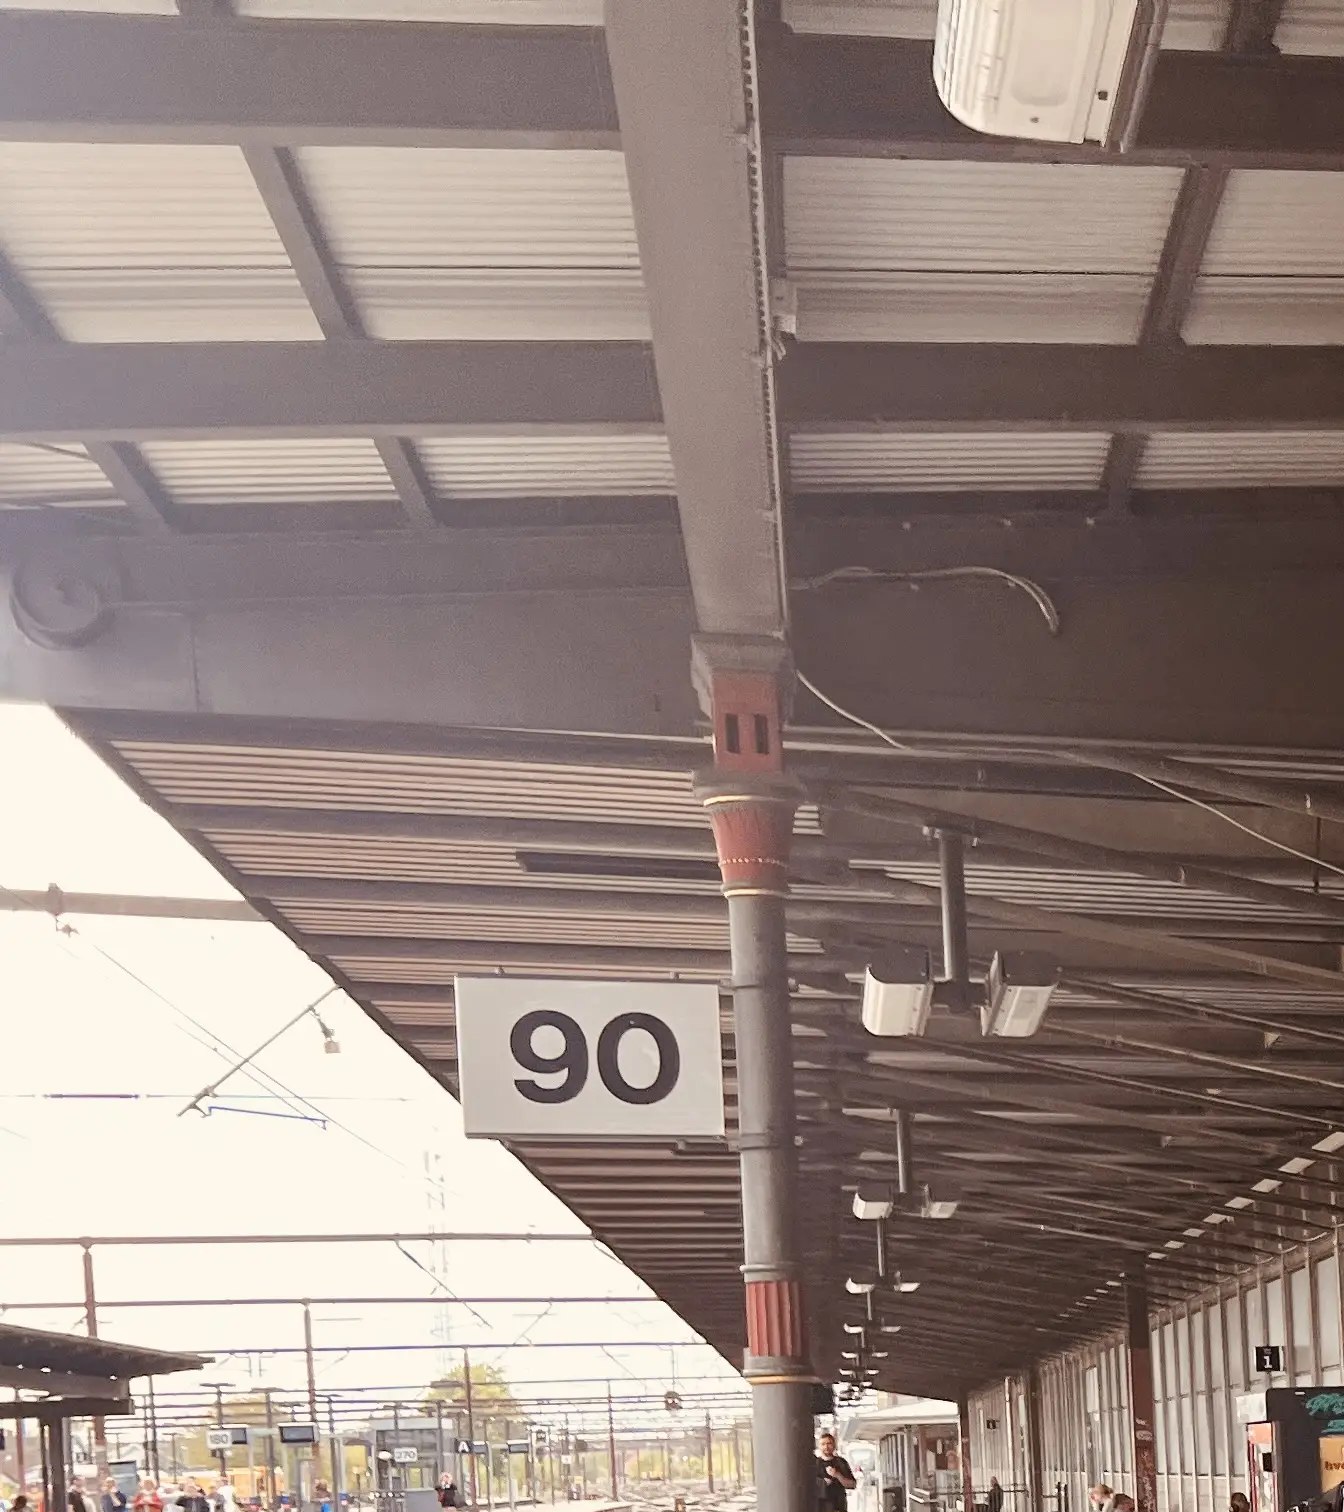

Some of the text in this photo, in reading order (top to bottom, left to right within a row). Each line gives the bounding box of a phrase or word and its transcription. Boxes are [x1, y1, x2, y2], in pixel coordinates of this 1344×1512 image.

[510, 1009, 681, 1105] 90
[1263, 1355, 1273, 1369] 1
[458, 1440, 470, 1453] A
